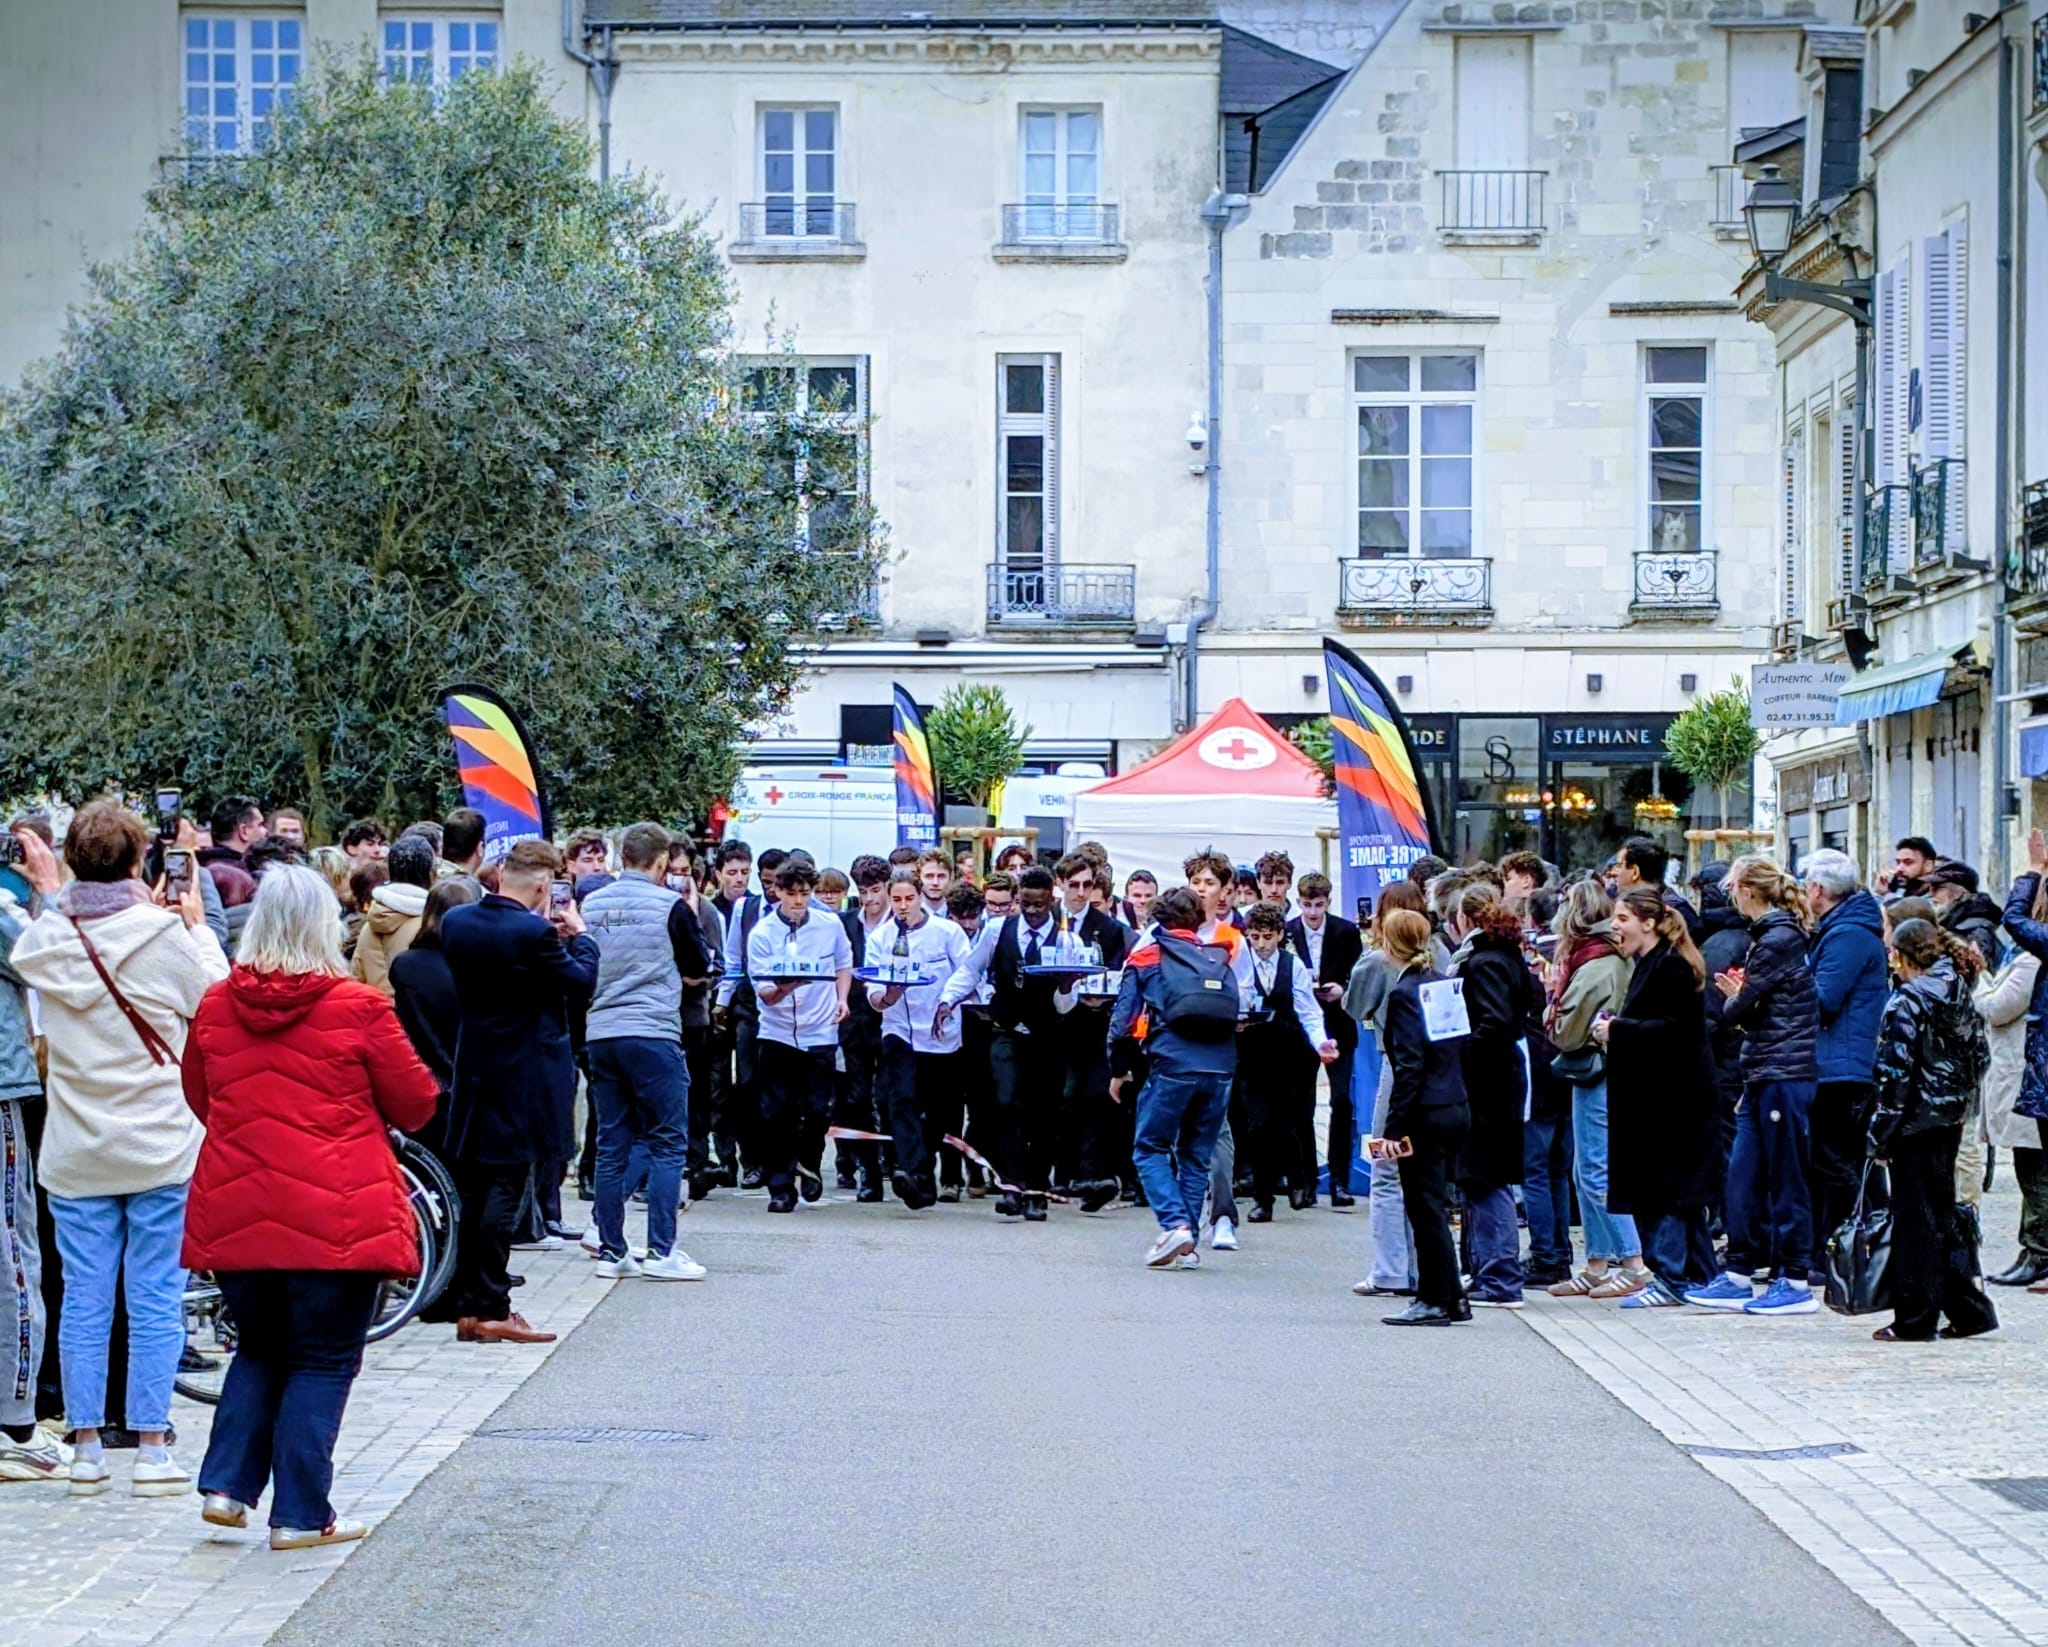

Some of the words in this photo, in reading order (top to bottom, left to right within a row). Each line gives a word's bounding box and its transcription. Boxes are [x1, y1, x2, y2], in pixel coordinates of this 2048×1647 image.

[1758, 671, 1813, 684] AUTHENTIC
[1820, 671, 1846, 683] MEN
[1763, 693, 1801, 705] COIFFEUR
[1552, 726, 1651, 745] STÉPHANE
[788, 791, 852, 802] CROIX-ROUGE
